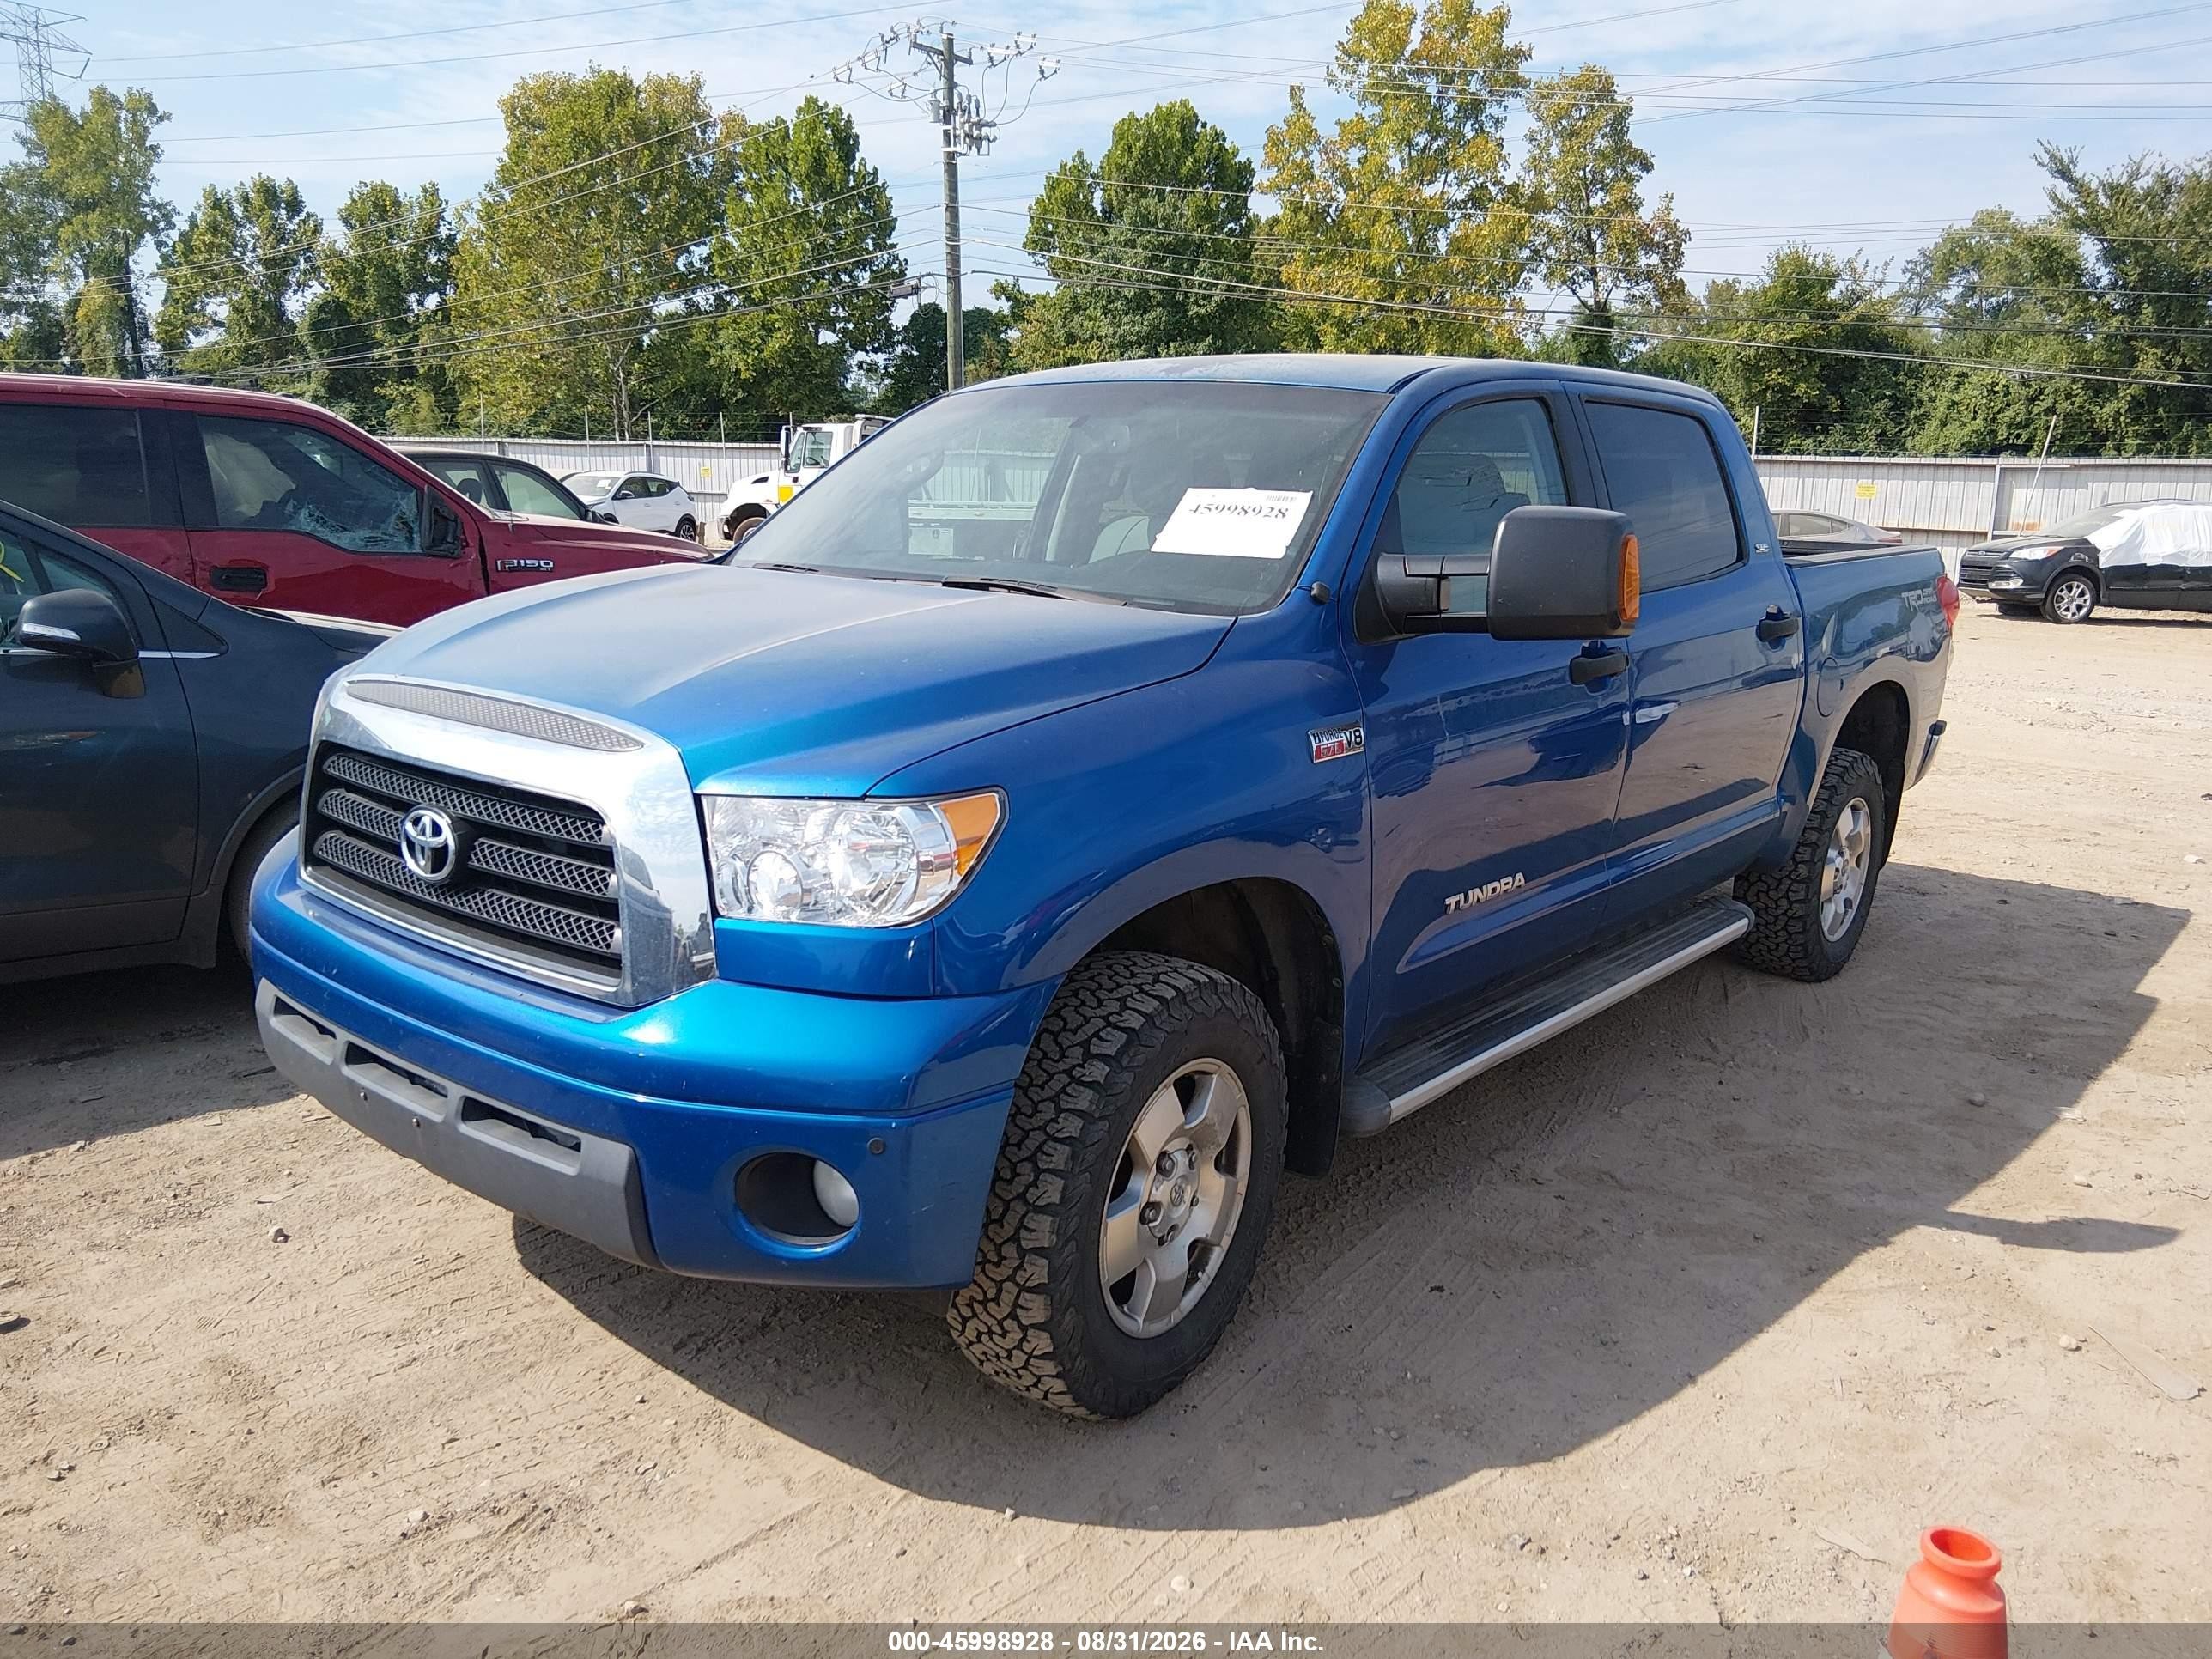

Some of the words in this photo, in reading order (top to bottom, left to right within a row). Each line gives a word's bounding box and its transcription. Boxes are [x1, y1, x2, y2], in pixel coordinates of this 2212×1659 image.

[1188, 502, 1289, 520] 45998928
[1900, 589, 1923, 611] TRD
[1344, 728, 1364, 748] V8
[1444, 872, 1526, 915] TUNDRA
